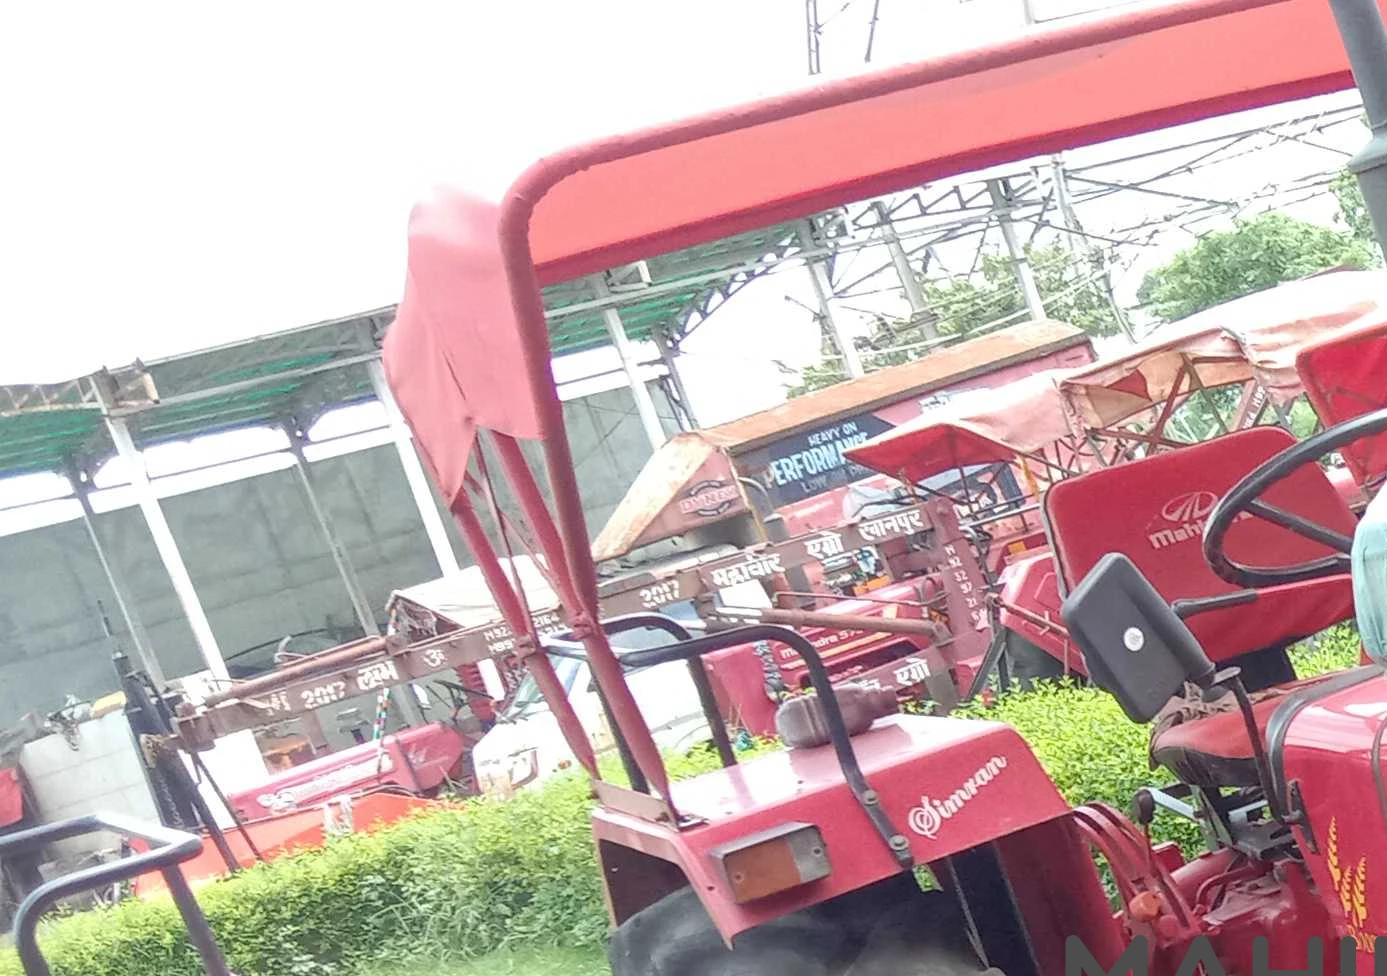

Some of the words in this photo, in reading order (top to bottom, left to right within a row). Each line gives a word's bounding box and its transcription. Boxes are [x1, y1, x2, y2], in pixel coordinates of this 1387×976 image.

[807, 427, 841, 447] HEAVY
[842, 421, 859, 436] ON
[907, 755, 1008, 839] Simran
